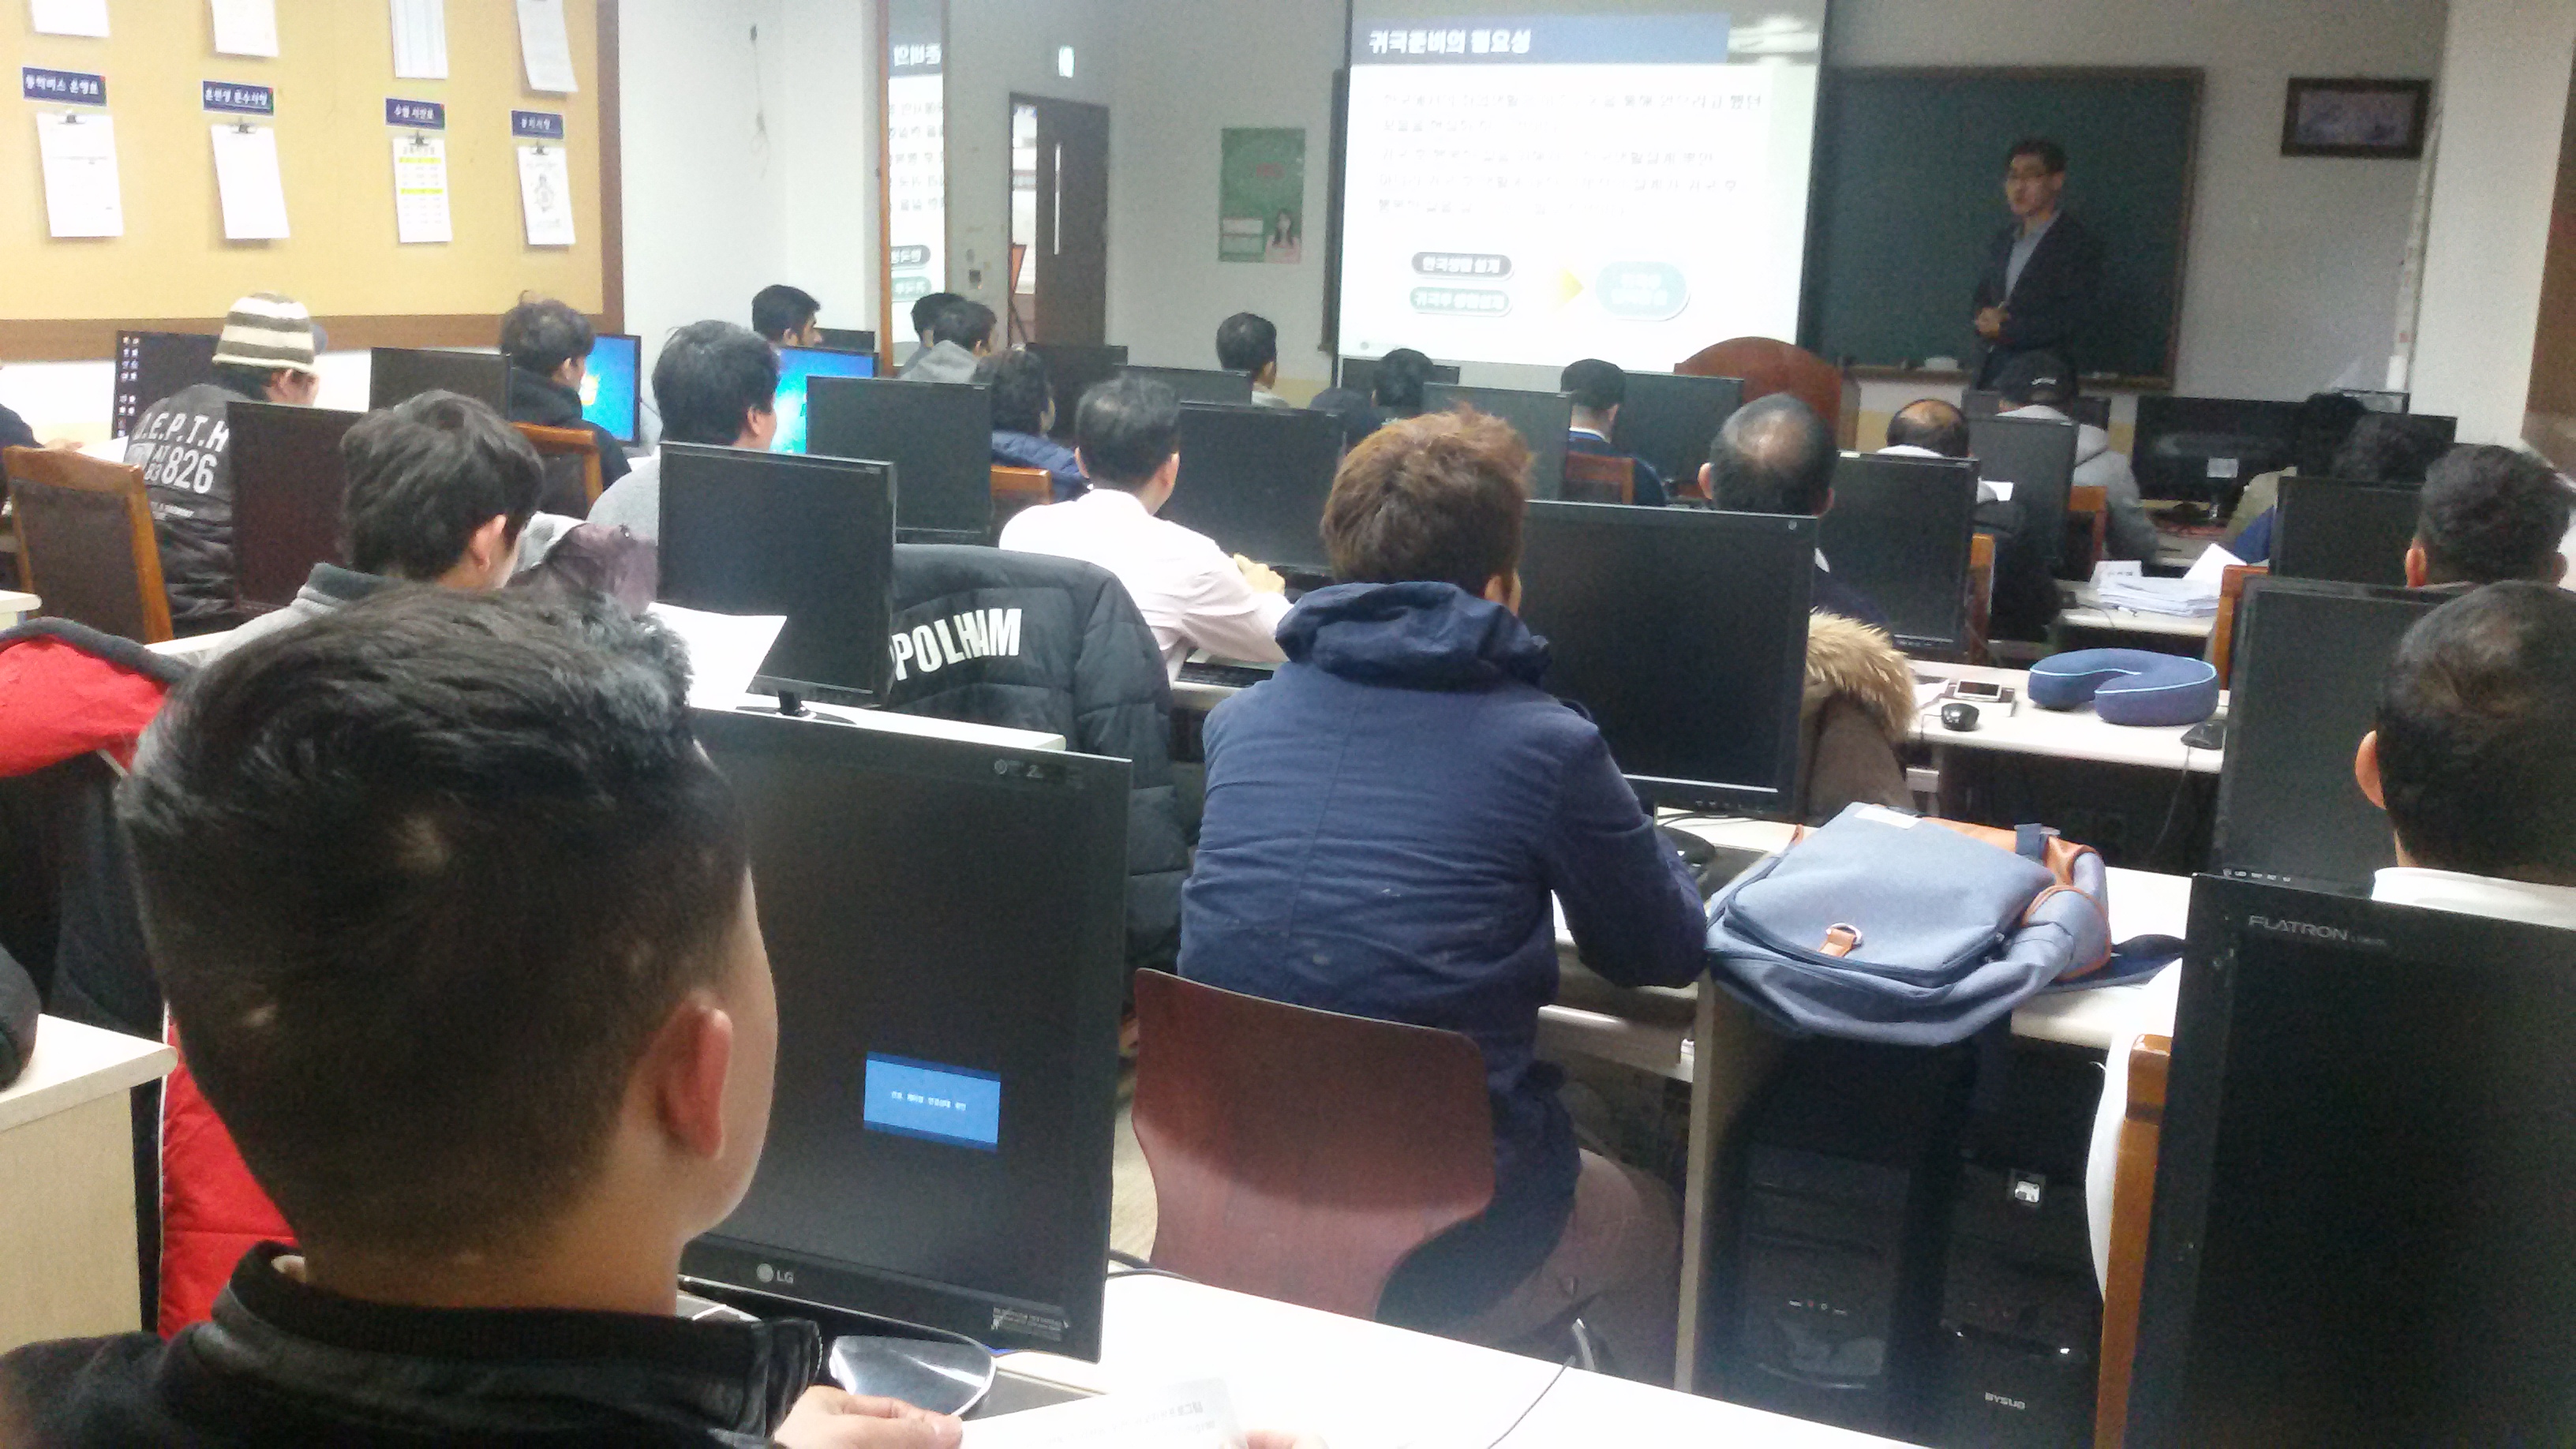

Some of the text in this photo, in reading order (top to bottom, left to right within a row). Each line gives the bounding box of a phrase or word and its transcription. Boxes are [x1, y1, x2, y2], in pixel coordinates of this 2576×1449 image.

[1369, 29, 1532, 54] 귀국준비의 필요성
[161, 446, 218, 494] 826
[891, 608, 1023, 681] POLHAM
[2248, 915, 2349, 942] FLATRON
[777, 1270, 794, 1284] LG
